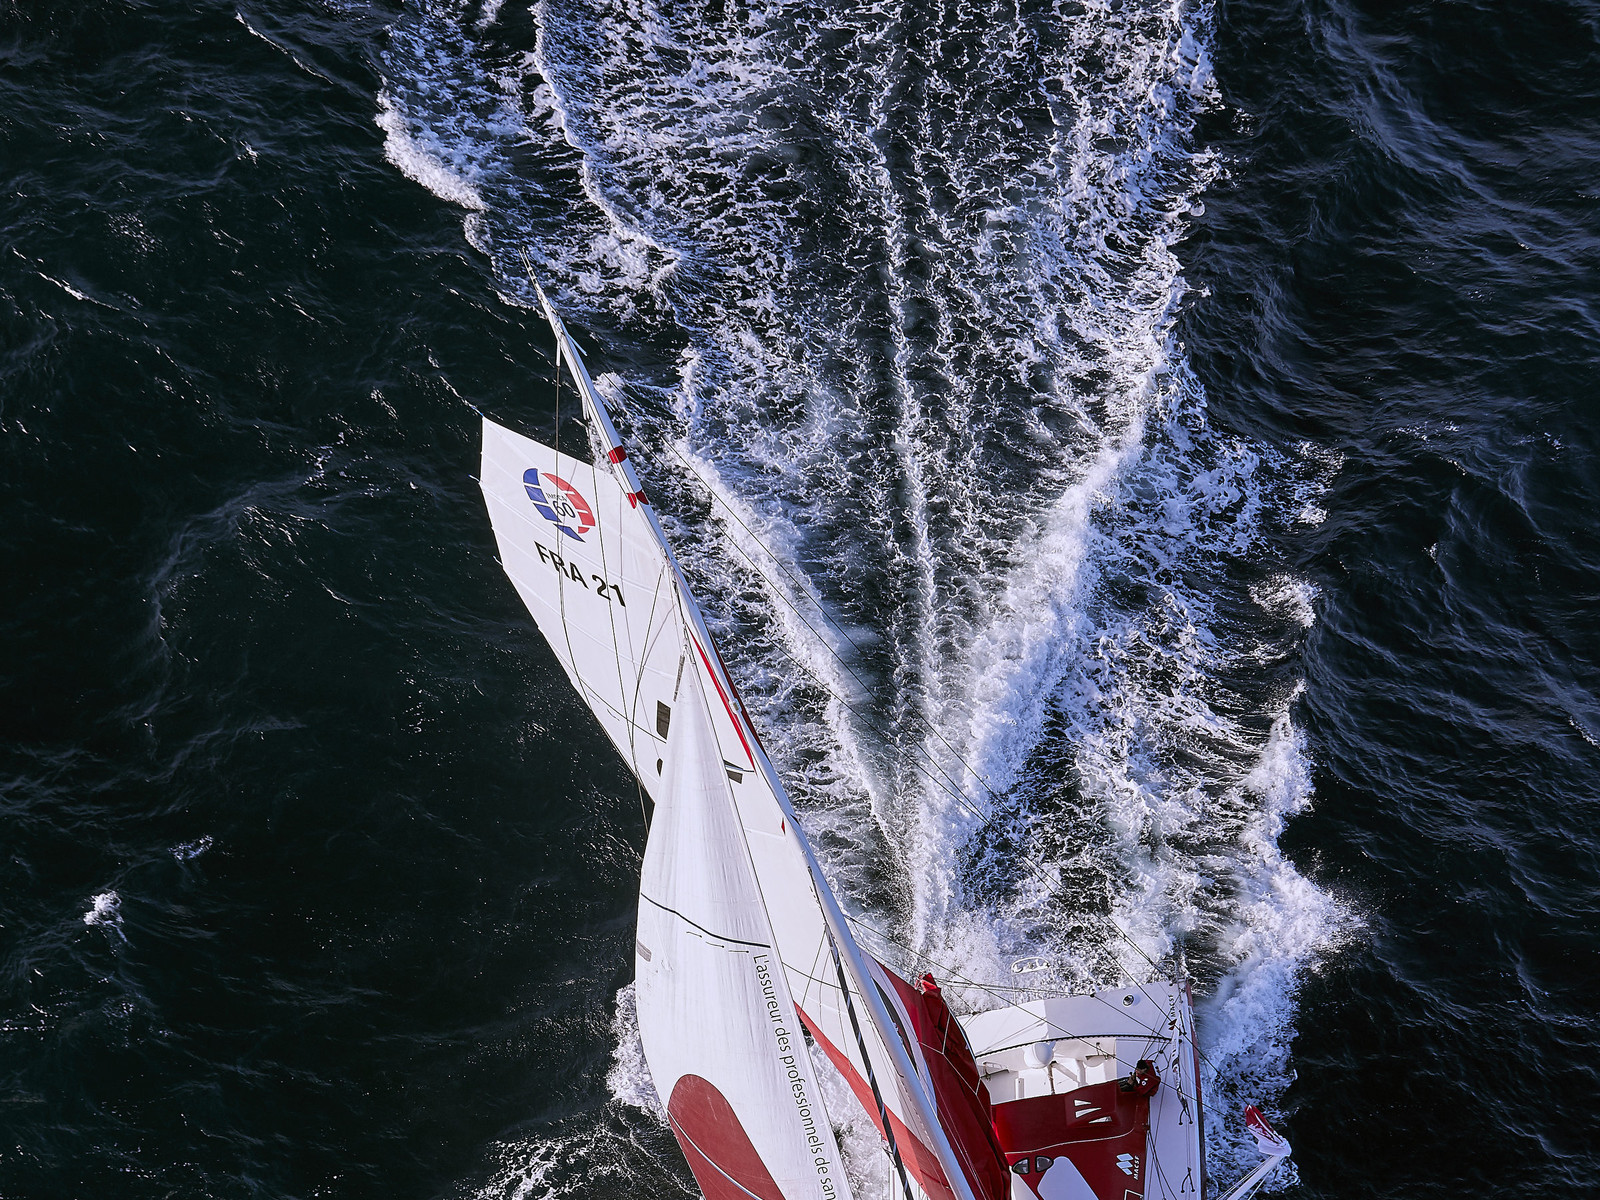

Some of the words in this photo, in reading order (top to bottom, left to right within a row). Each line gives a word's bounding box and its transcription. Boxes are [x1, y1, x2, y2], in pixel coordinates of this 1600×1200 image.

[553, 500, 576, 518] 60
[534, 541, 589, 590] FRA
[591, 574, 626, 608] 21
[753, 954, 783, 1024] L'assureur
[775, 1027, 791, 1053] des
[779, 1055, 825, 1155] professionnels
[814, 1157, 831, 1175] de
